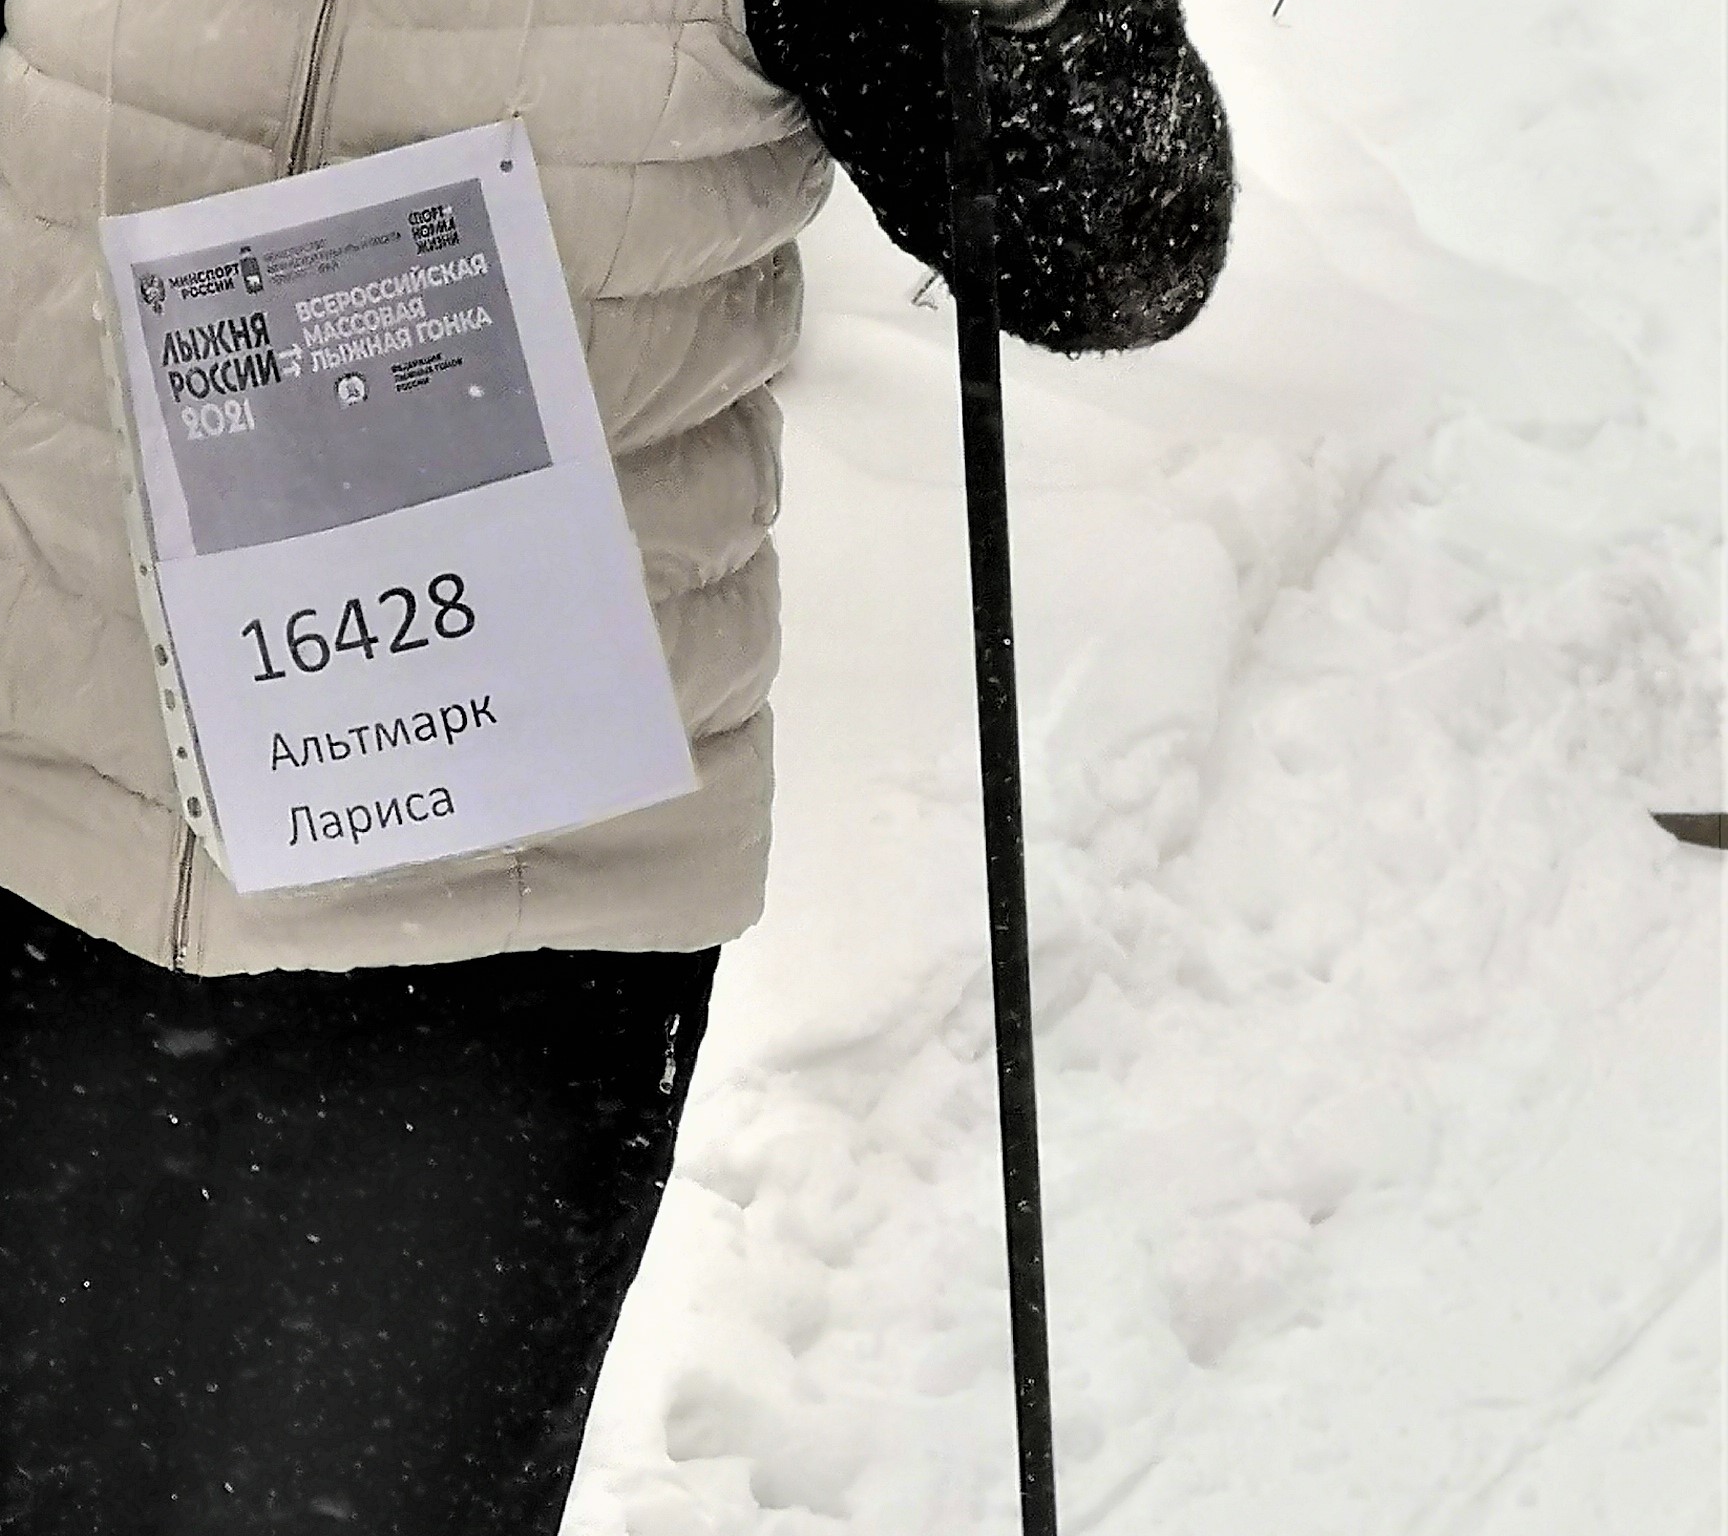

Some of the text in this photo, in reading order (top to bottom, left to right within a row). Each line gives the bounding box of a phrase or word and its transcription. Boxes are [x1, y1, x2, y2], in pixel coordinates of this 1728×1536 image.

[169, 263, 239, 288] МИНСПОРТ
[181, 277, 235, 299] РОССИИ
[295, 253, 488, 322] ВСЕРОССИЙСКАЯ
[162, 312, 270, 367] ЛЫЖНЯ
[302, 295, 425, 347] МАССОВАЯ
[310, 306, 493, 373] ЛЫЖНАЯ ГОНКА
[168, 349, 281, 403] РОССИИ
[181, 399, 255, 440] 2021
[241, 573, 475, 681] 16428
[271, 695, 497, 771] Альтмарк
[289, 786, 455, 846] Лариса
